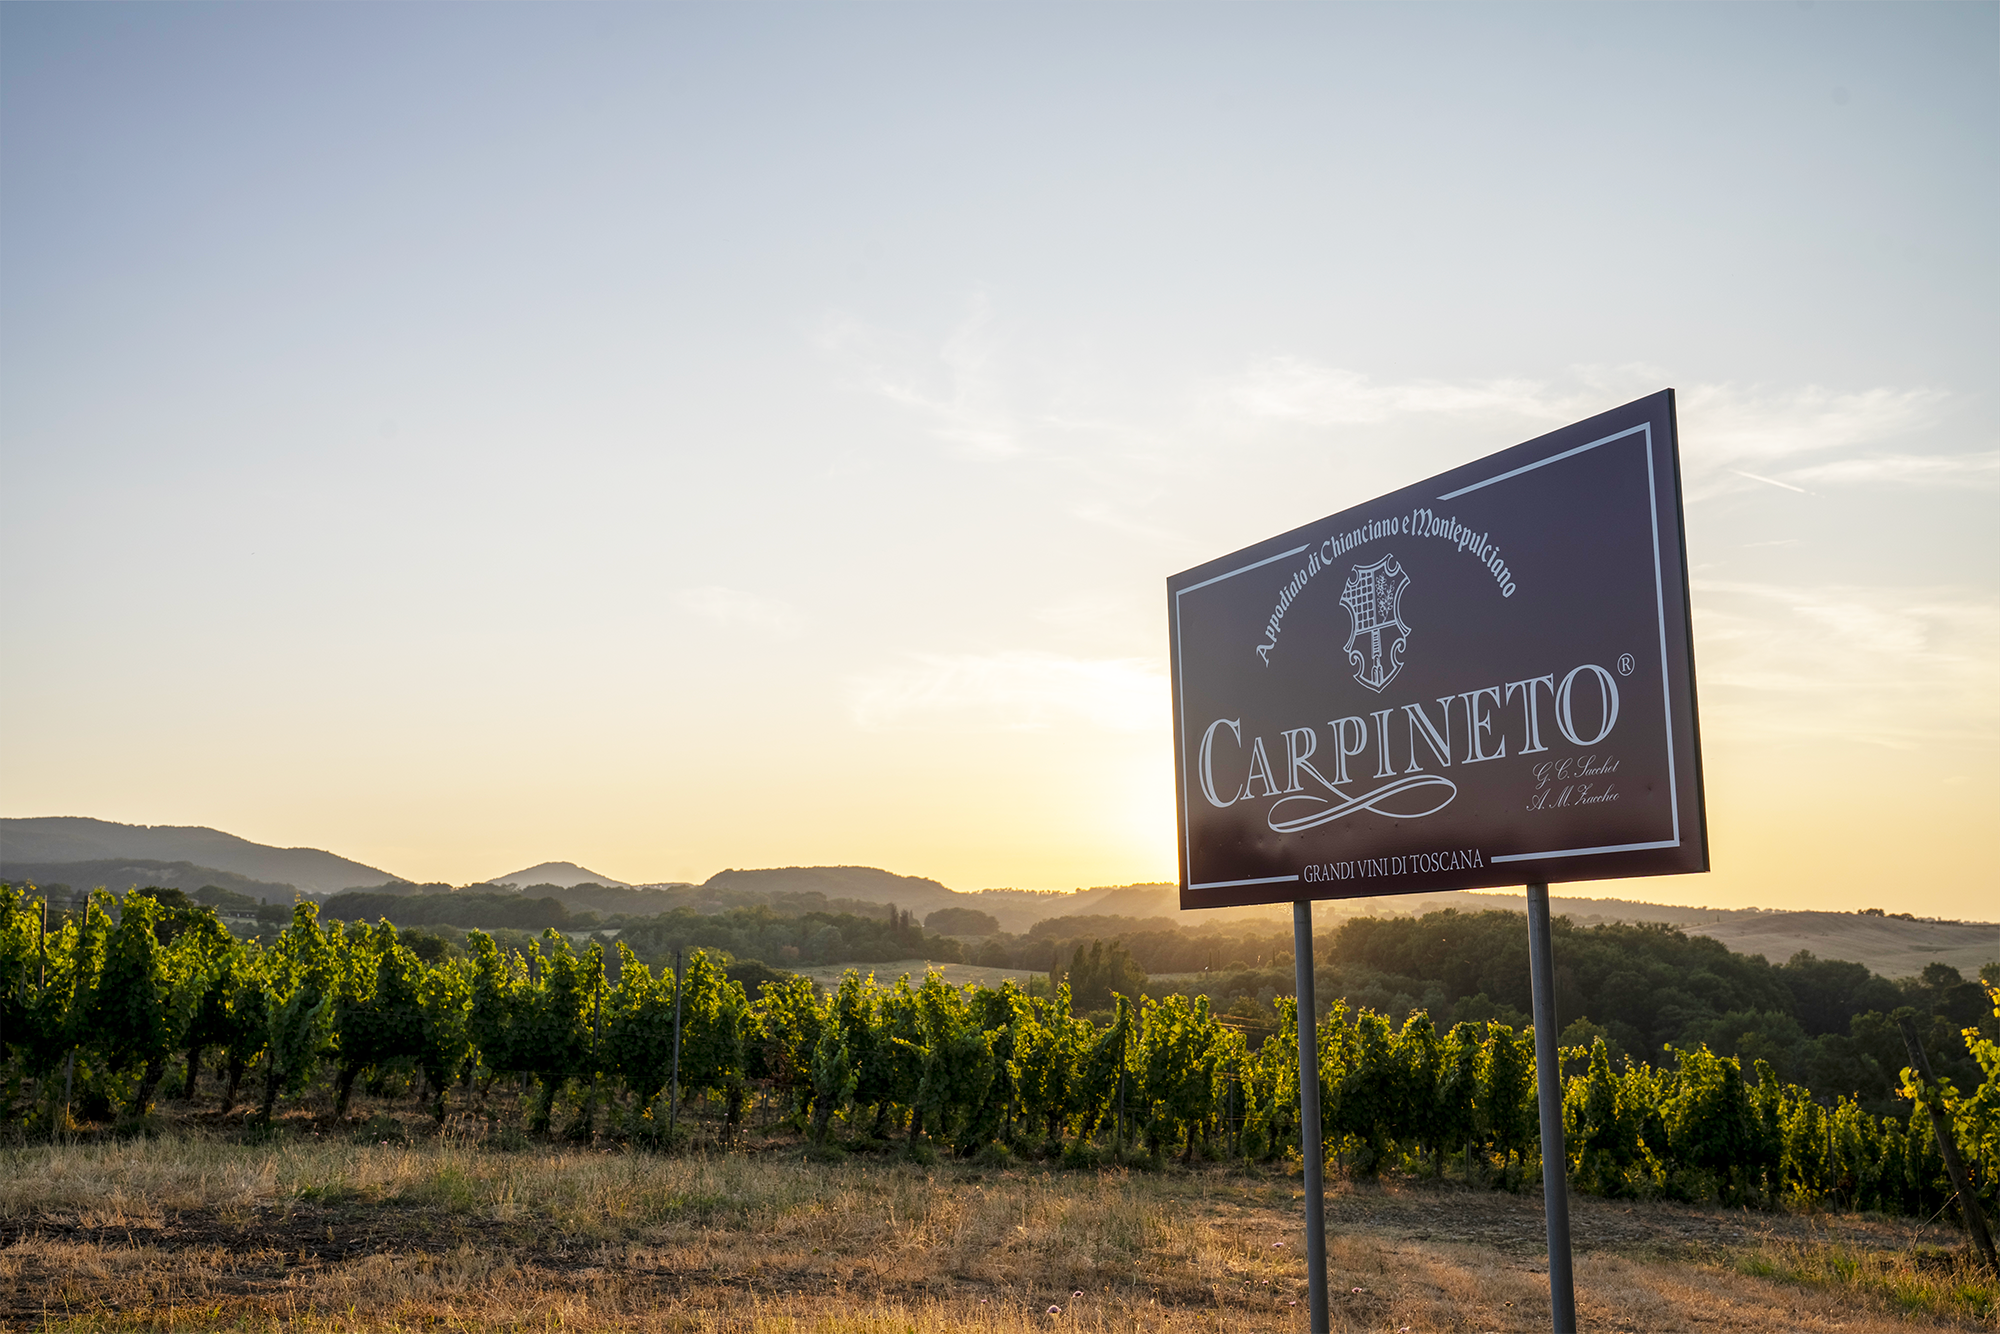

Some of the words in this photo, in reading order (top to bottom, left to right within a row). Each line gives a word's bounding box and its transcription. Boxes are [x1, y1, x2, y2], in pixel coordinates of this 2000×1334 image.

[1255, 571, 1308, 668] Appodiato
[1308, 551, 1321, 578] di
[1320, 515, 1399, 566] Chianciano
[1402, 515, 1409, 535] e
[1411, 508, 1517, 599] Montepulciano
[1303, 860, 1355, 883] GRANDI
[1357, 857, 1389, 878] VINI
[1391, 855, 1408, 876] DI
[1409, 848, 1484, 873] TOSCANA
